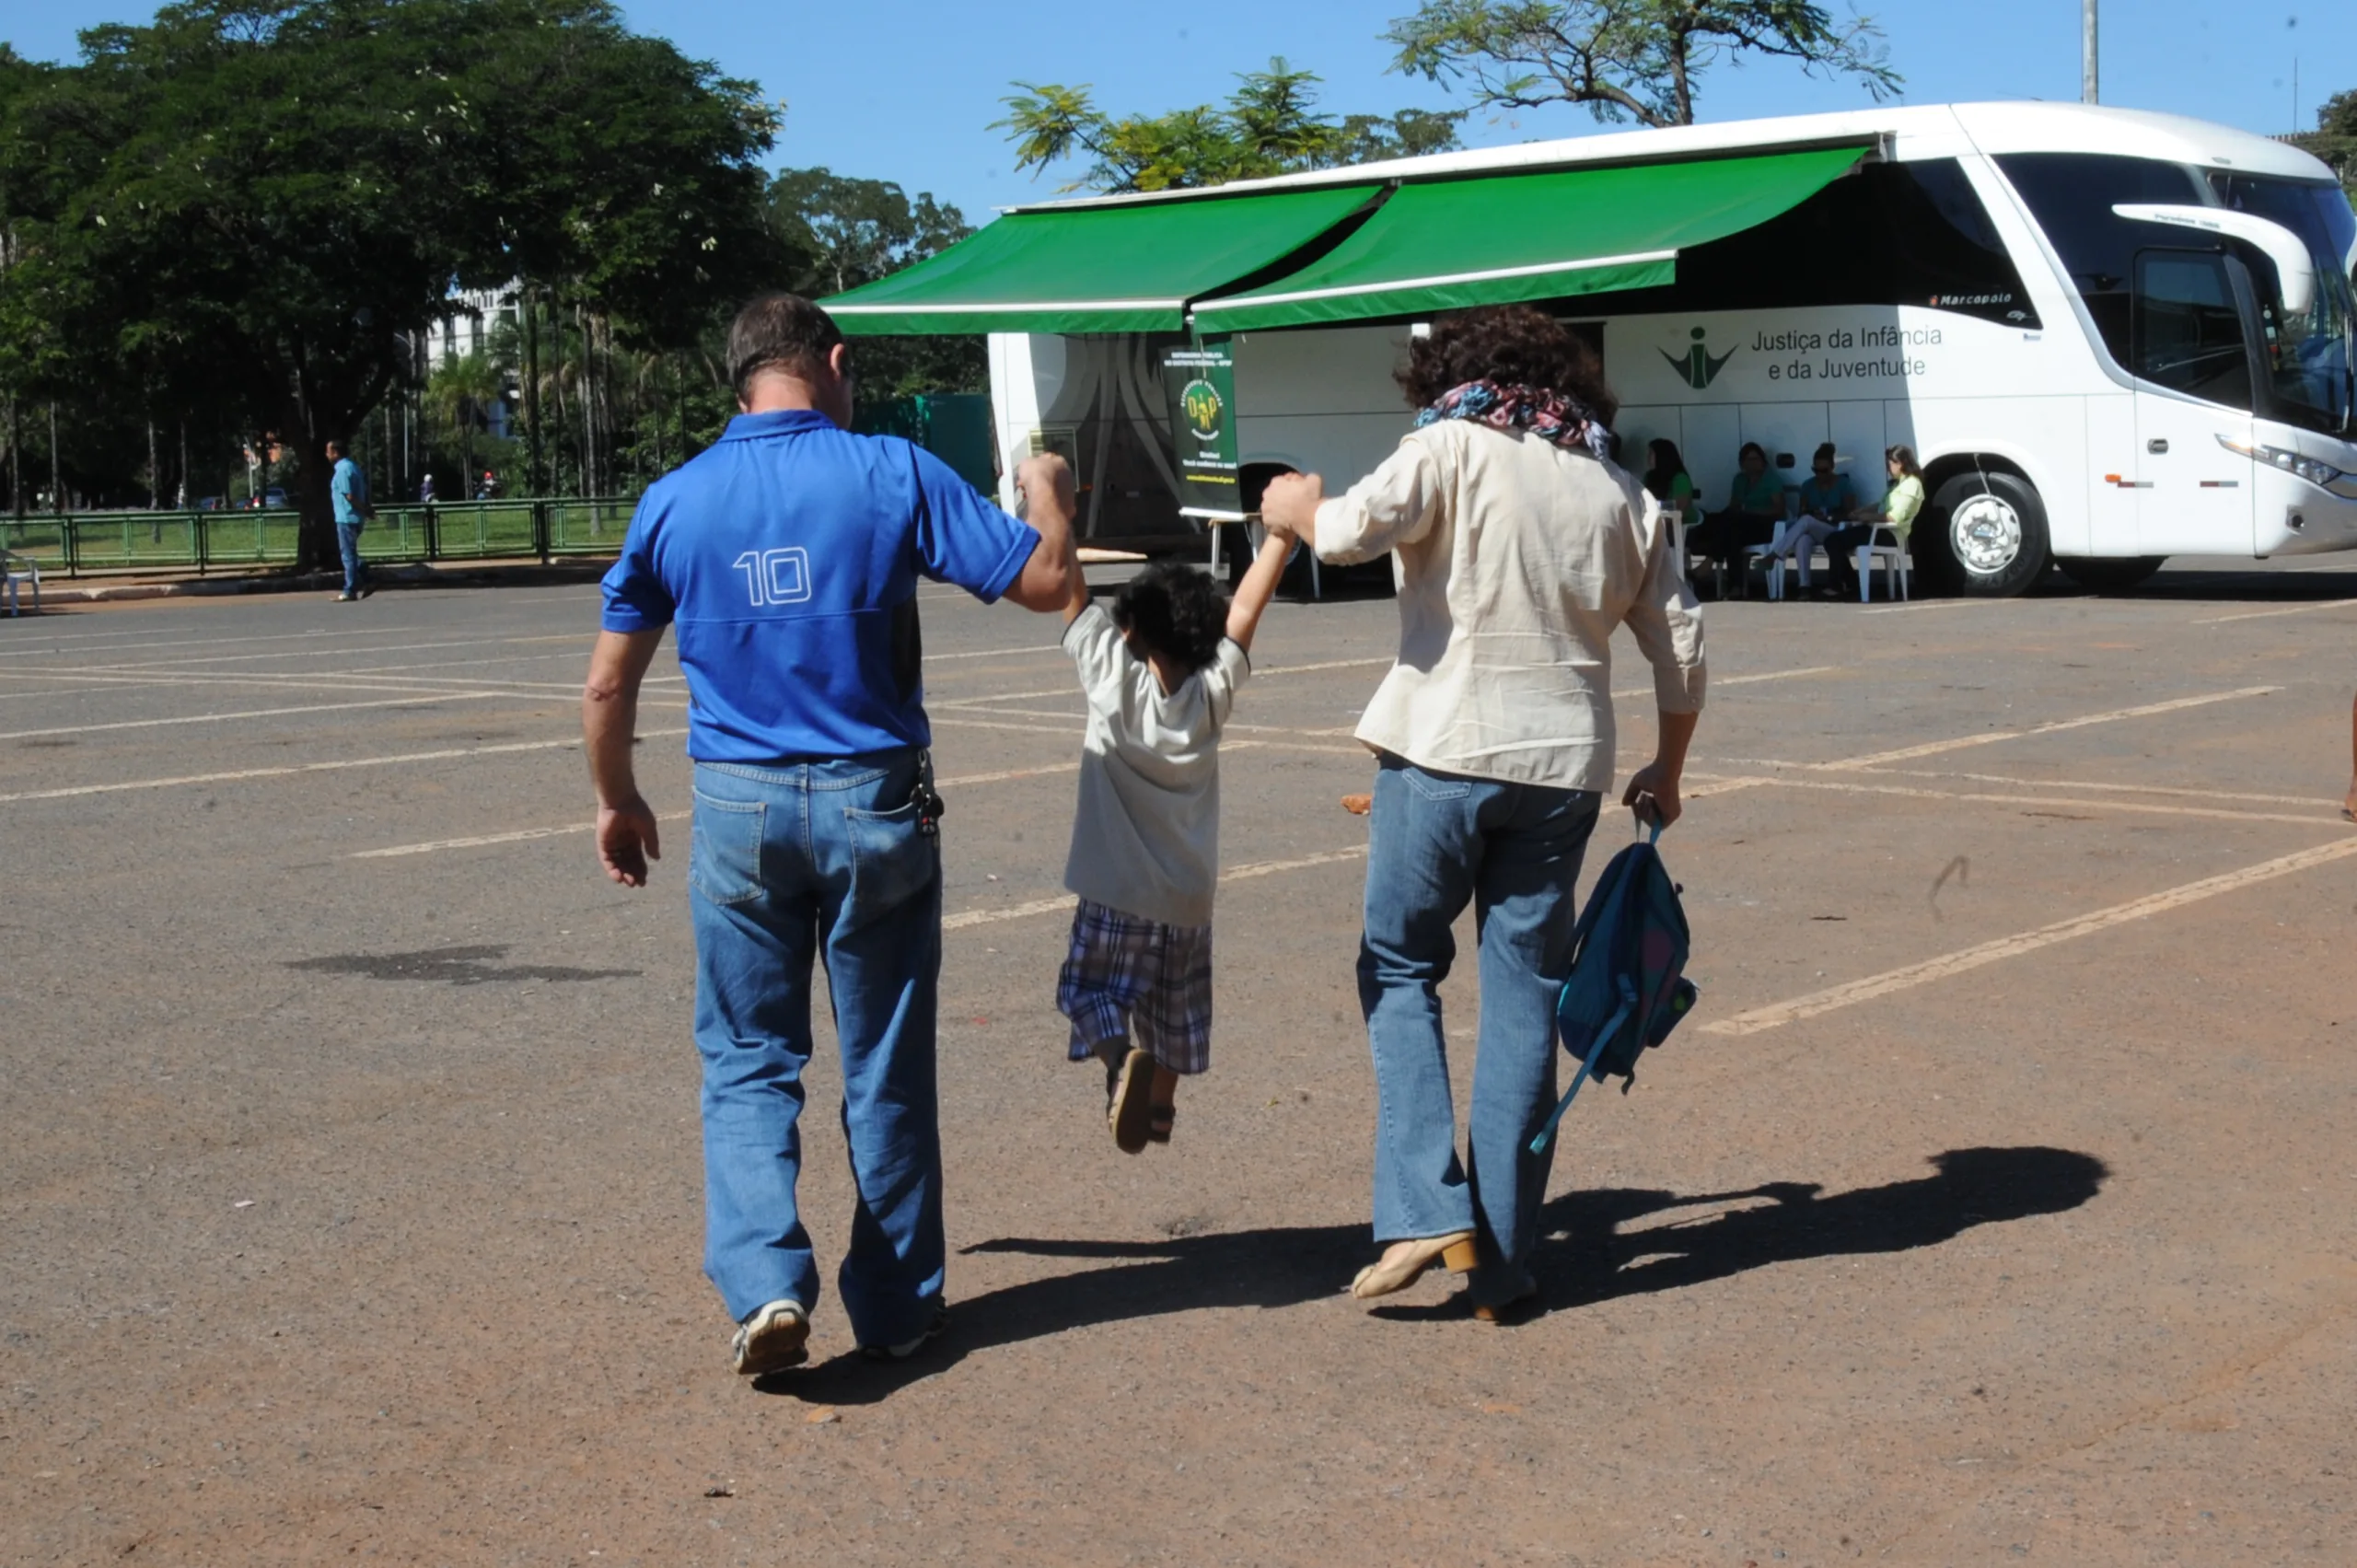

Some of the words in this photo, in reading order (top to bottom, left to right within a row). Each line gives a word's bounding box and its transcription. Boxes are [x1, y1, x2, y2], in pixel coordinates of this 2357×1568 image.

[1940, 293, 2012, 306] Marcopolo
[1751, 330, 1821, 354] Justiça
[1828, 328, 1853, 349] da
[1861, 324, 1943, 348] Infância
[1768, 363, 1781, 380] e
[1787, 359, 1812, 380] da
[1818, 356, 1926, 379] Juventude
[732, 546, 812, 607] 10
